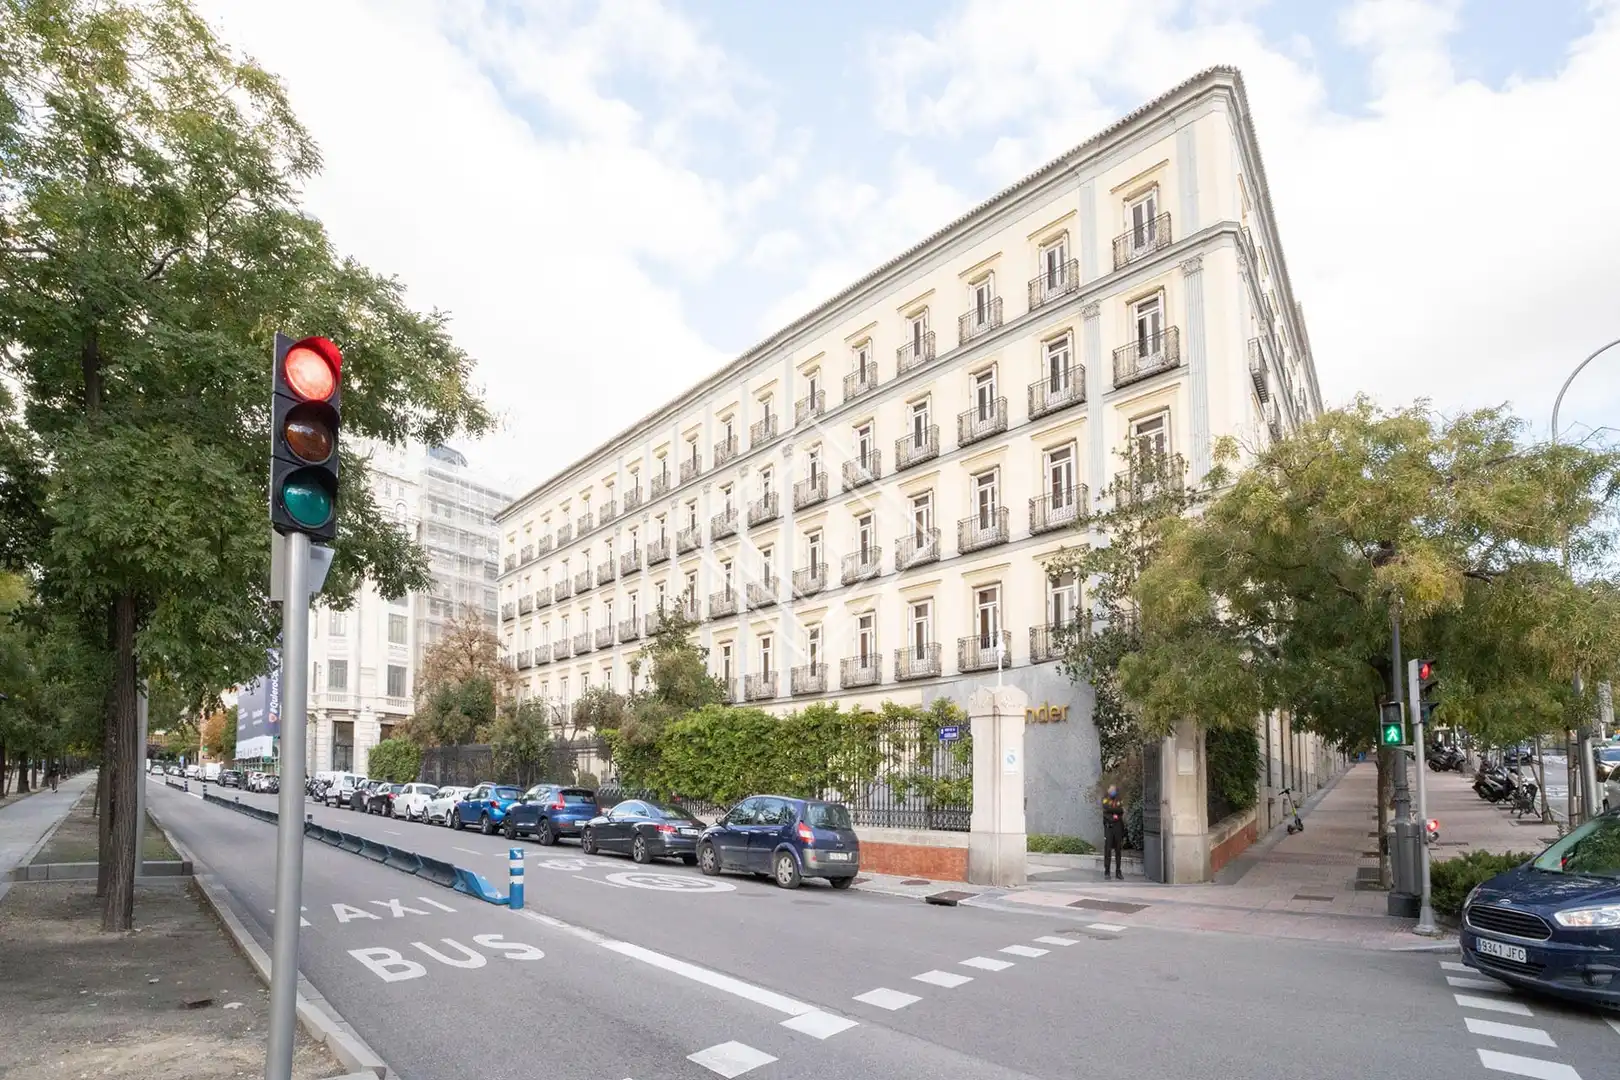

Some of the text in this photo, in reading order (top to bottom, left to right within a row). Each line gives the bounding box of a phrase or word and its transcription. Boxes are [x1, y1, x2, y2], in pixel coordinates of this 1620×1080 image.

[1024, 699, 1068, 723] nder
[347, 934, 545, 983] BUS
[1482, 940, 1525, 961] 9341 JFC
